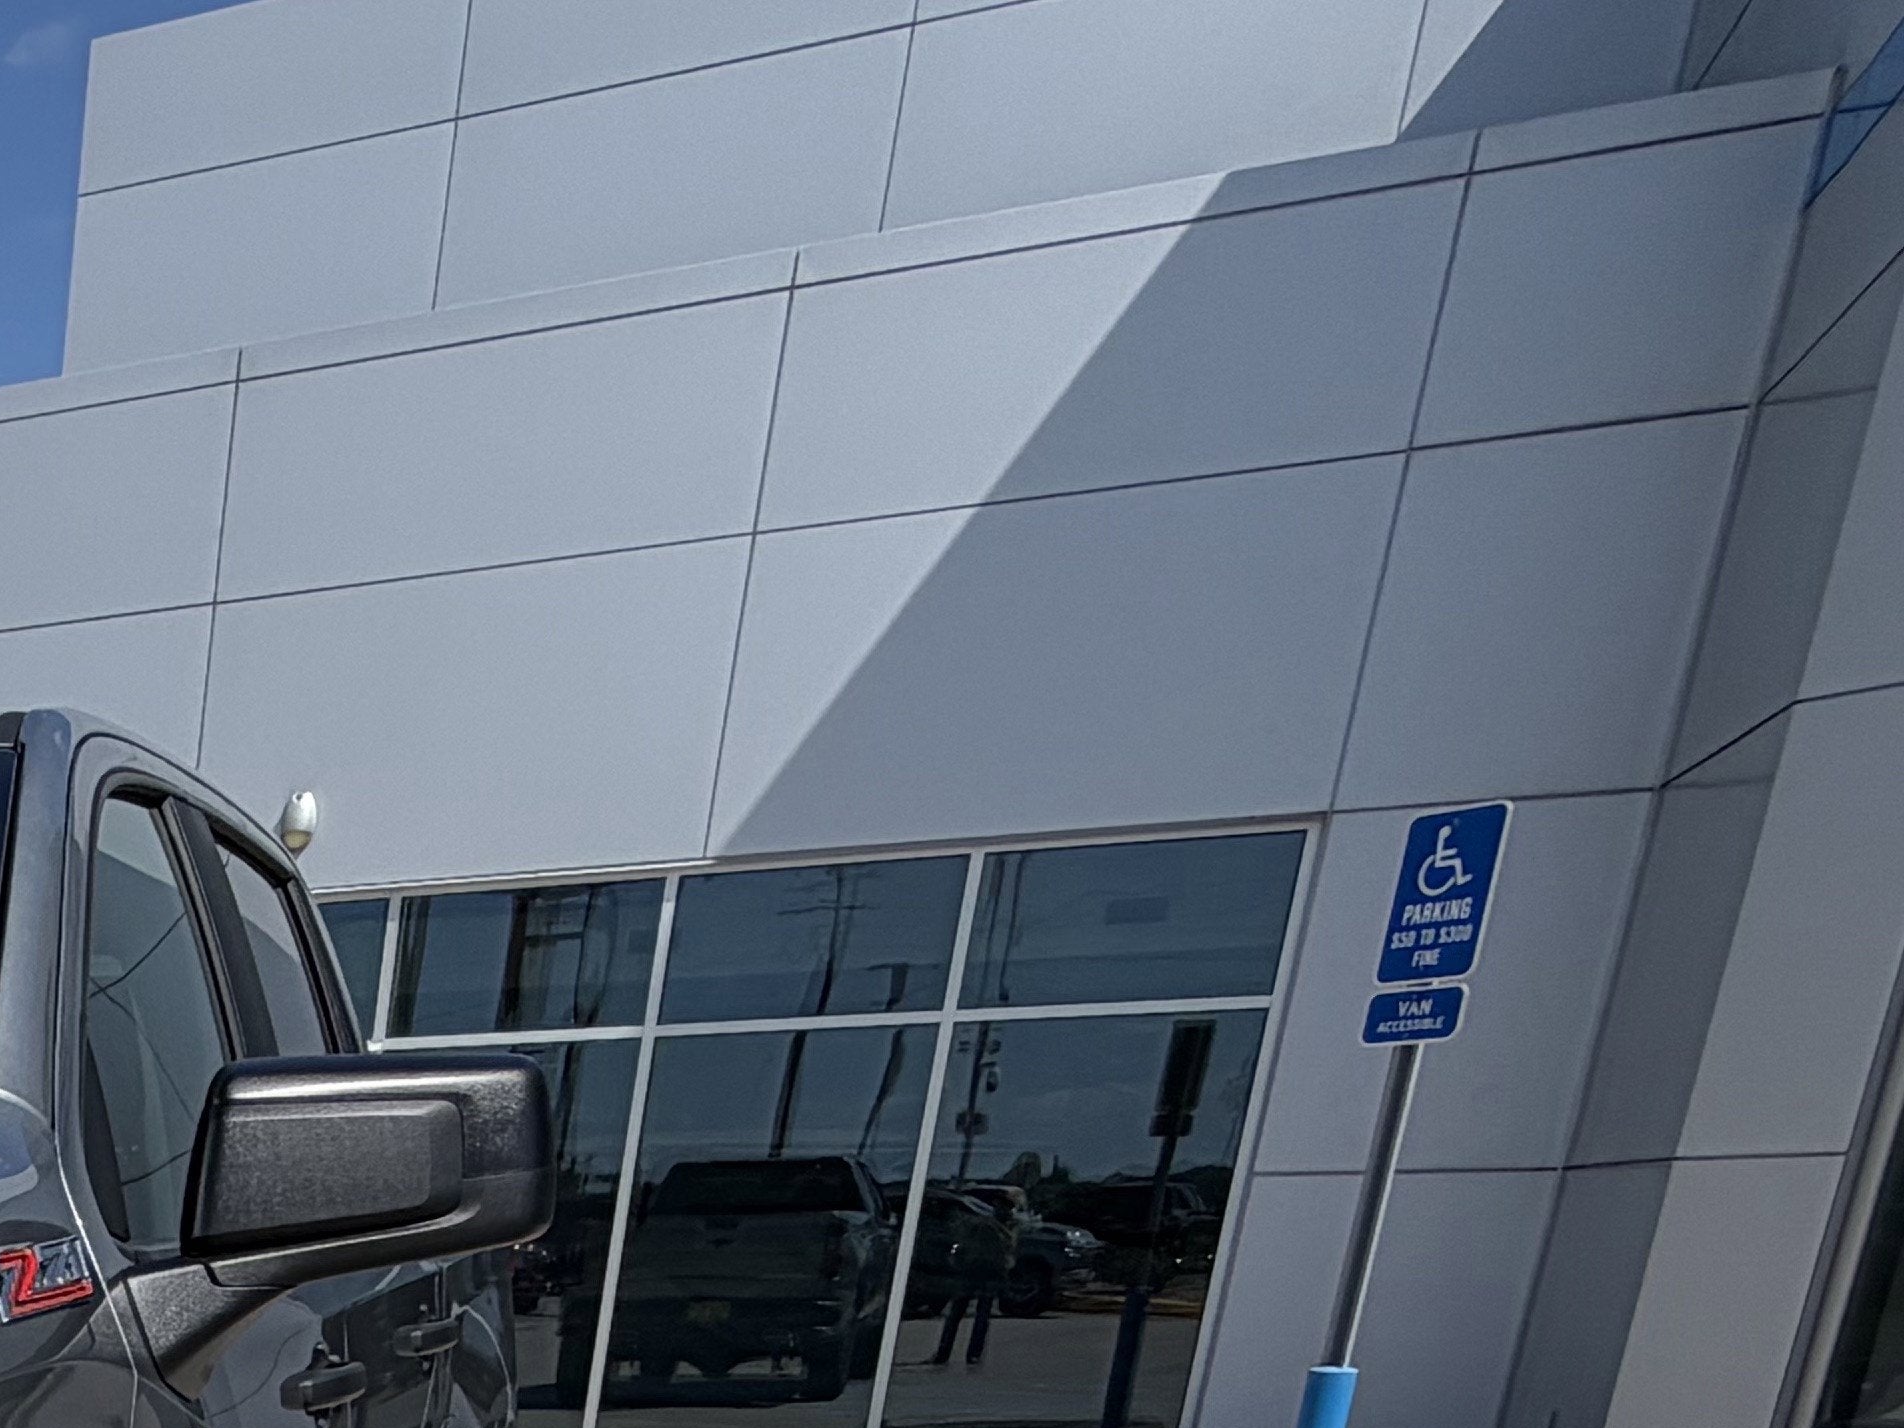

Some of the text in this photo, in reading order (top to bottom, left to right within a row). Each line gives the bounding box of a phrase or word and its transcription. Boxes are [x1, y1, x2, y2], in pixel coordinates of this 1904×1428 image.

[1401, 897, 1473, 926] PARKING
[1420, 928, 1436, 946] TO
[1412, 949, 1440, 967] FINE
[1398, 998, 1434, 1018] VAN
[1377, 1016, 1445, 1033] ACCESSIBLE
